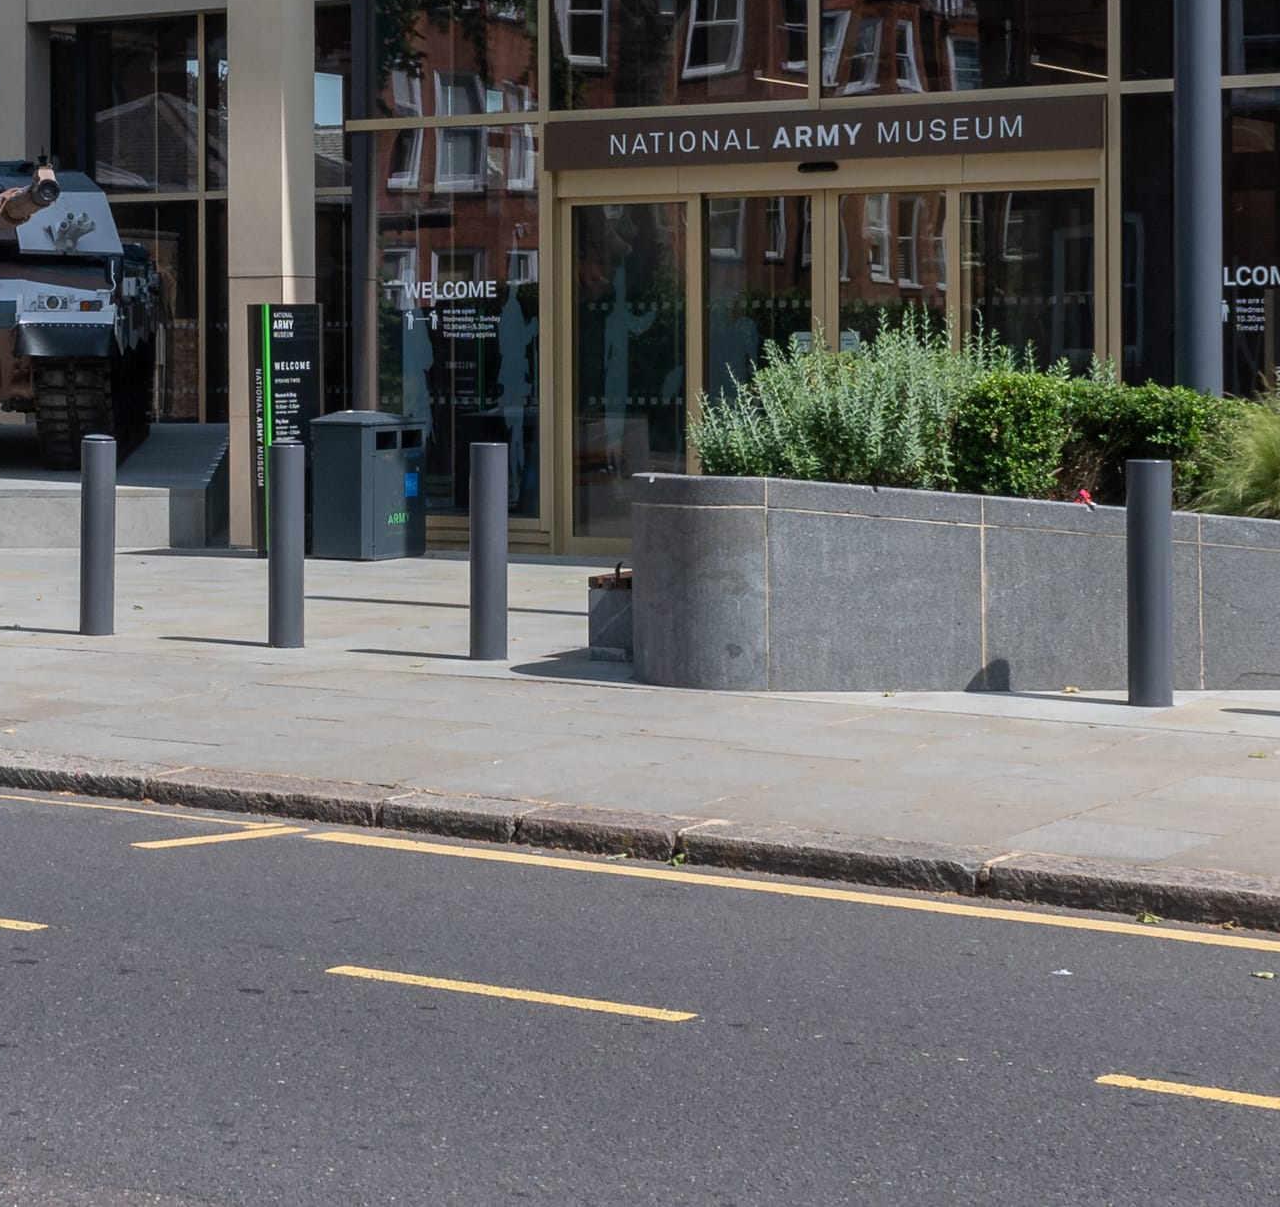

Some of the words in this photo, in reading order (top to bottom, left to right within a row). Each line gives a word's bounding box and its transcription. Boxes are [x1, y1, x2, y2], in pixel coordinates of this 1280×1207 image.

[609, 128, 761, 155] NATIONAL
[772, 123, 862, 149] ARMY
[877, 115, 1023, 144] MUSEUM
[404, 280, 498, 299] WELCOME
[273, 319, 294, 330] ARMY
[274, 360, 311, 371] WELCOME
[255, 368, 263, 413] NATIONAL
[256, 416, 264, 443] ARMY
[257, 446, 265, 487] MUSEUM
[387, 512, 410, 525] ARMY
